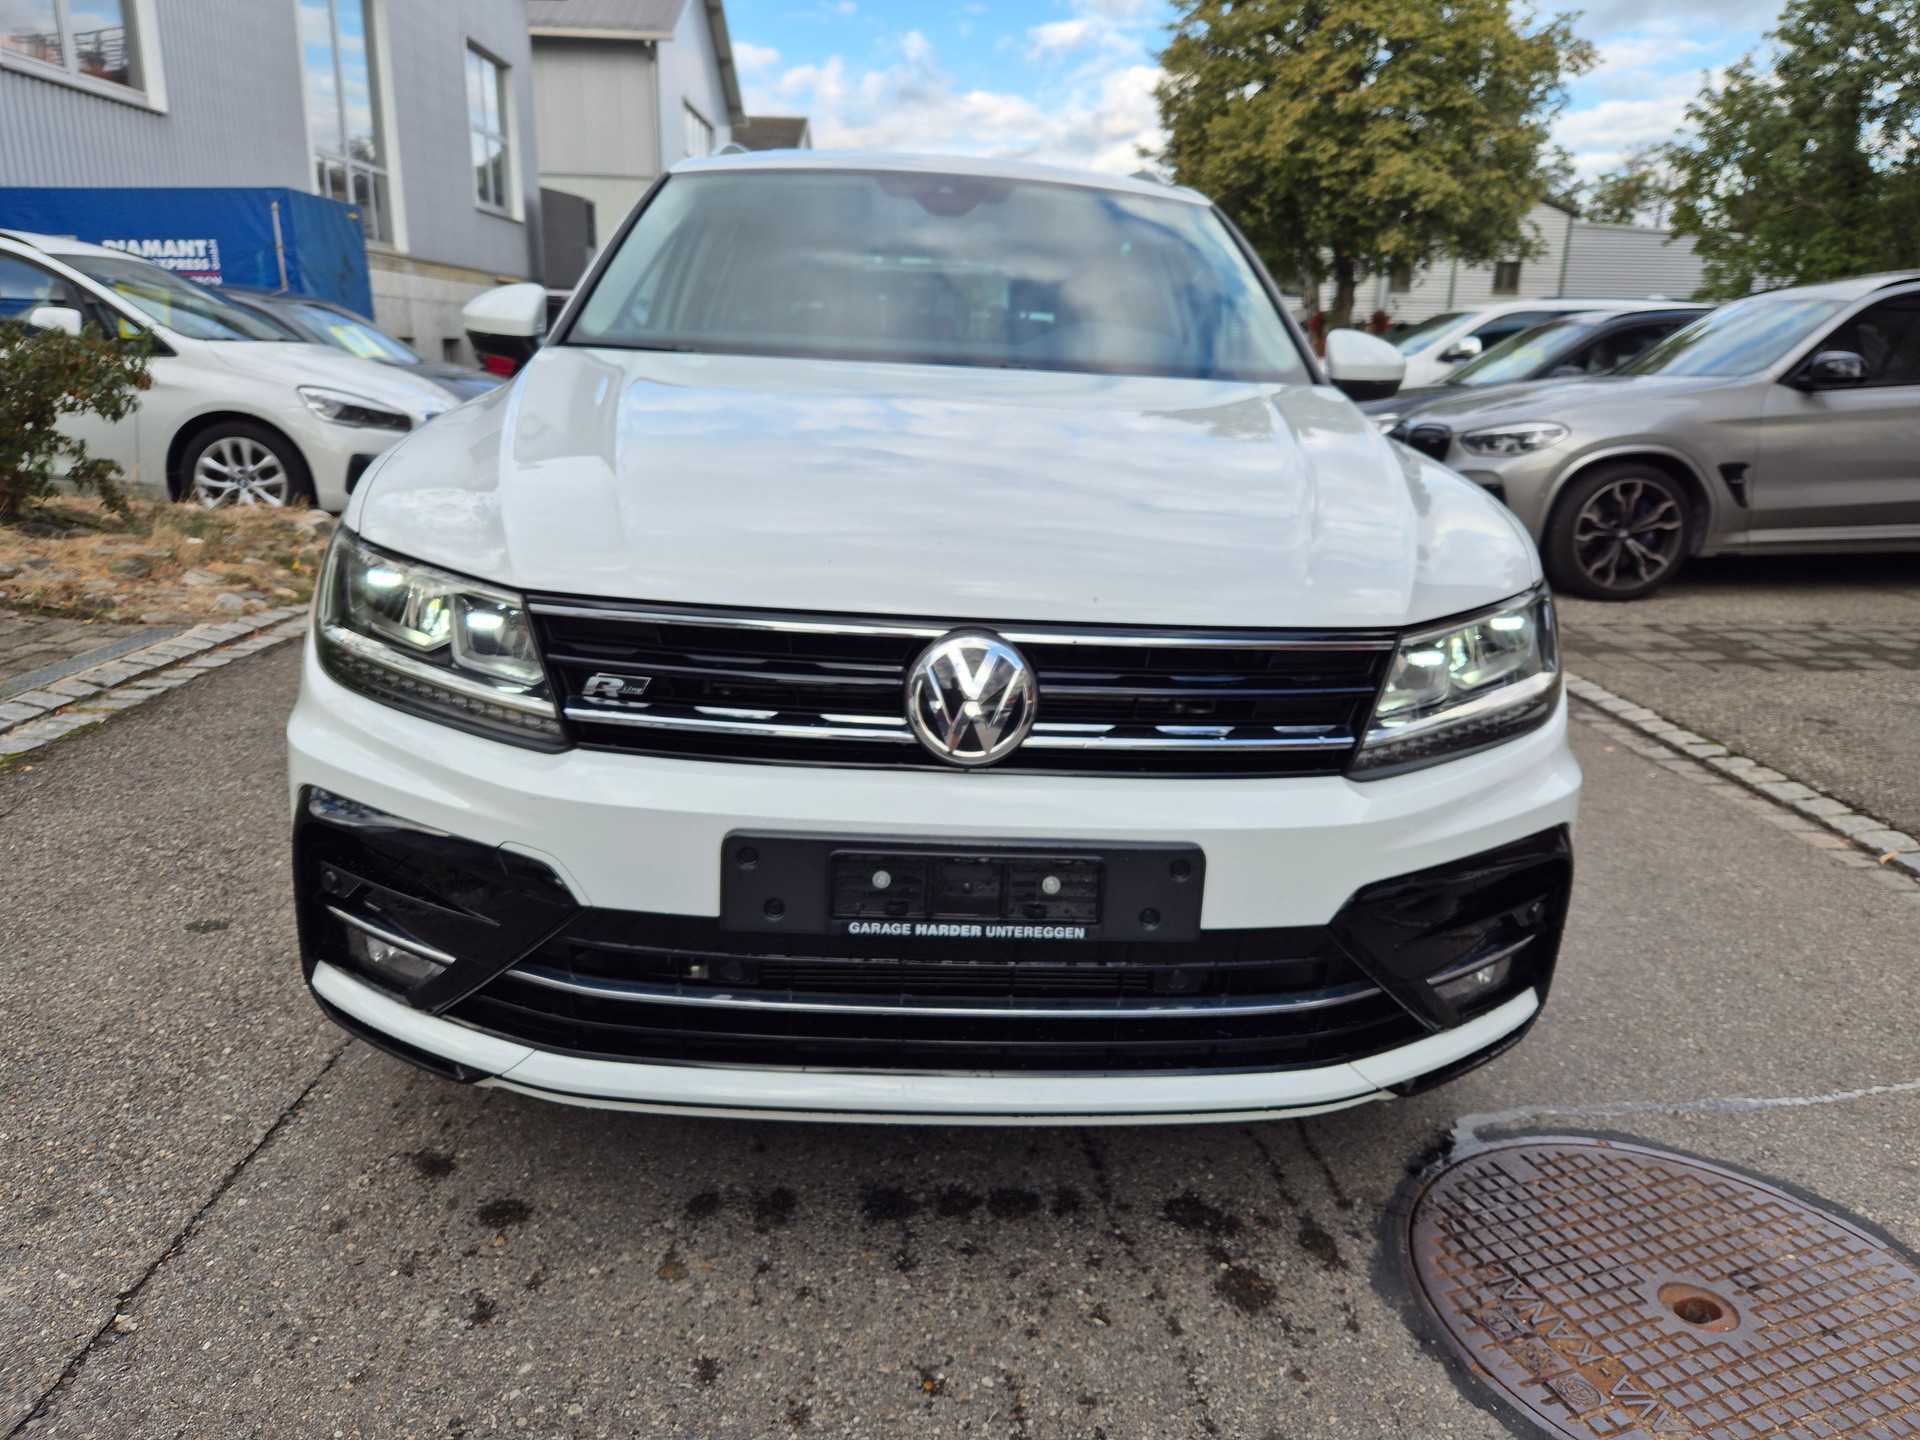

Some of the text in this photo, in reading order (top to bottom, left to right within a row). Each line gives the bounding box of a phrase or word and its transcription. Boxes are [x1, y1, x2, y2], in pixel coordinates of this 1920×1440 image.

[848, 922, 1086, 940] GARAGE HARDER UNTEREGGEN
